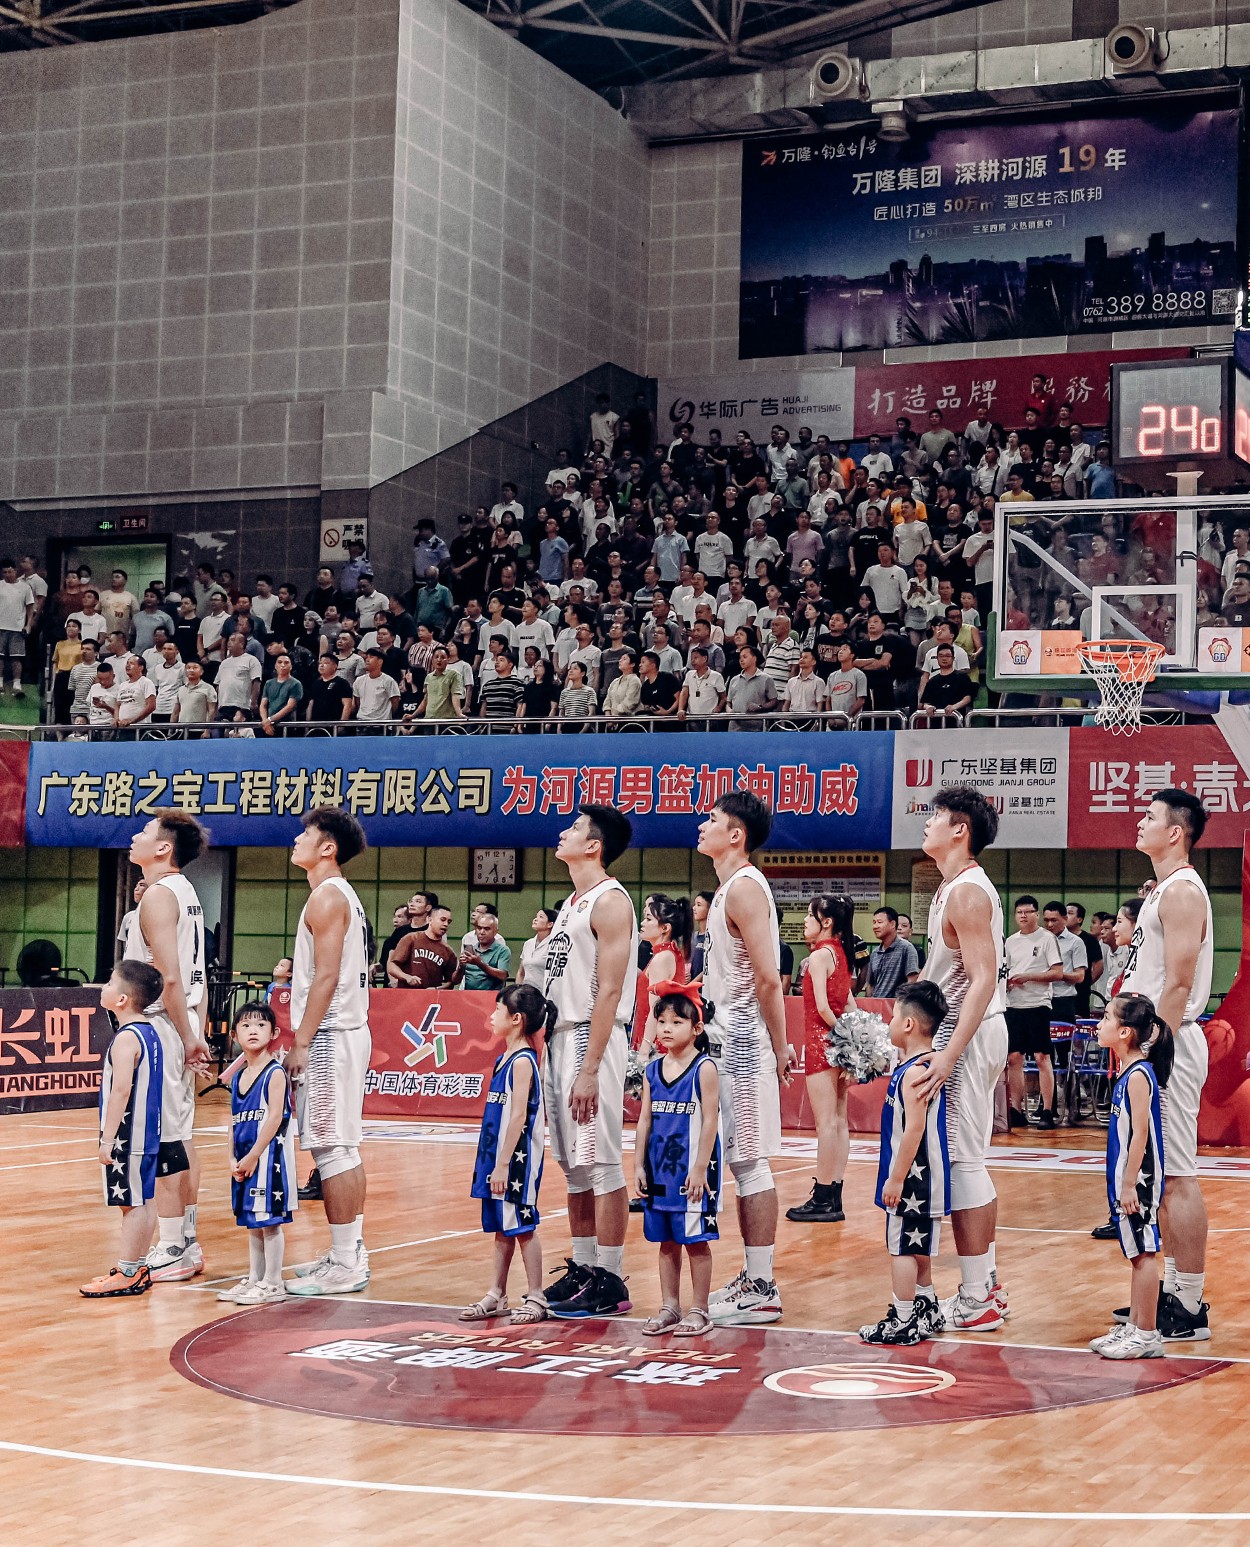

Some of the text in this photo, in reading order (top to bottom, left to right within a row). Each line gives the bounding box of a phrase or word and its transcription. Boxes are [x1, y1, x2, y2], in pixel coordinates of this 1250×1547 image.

[852, 145, 1127, 195] 万隆集团 深耕河源 19 年
[873, 187, 1103, 222] 匠心打造 湾区生态城邦
[1083, 307, 1104, 317] 0762
[1106, 295, 1146, 315] 389
[1152, 290, 1206, 312] 8888
[699, 398, 780, 420] 华际广告
[782, 403, 842, 414] ADVERTISING
[867, 391, 998, 417] 打造品牌
[940, 757, 1057, 776] 广东坚基集团
[37, 768, 493, 817] 广东路之宝工程材料有限公司
[501, 763, 860, 817] 为河源男篮加油助威
[1008, 796, 1056, 808] 坚基地产
[414, 948, 444, 966] ADIDAS
[364, 1071, 483, 1099] 中国体育彩票
[408, 1332, 738, 1362] PEARL RIVER
[286, 1339, 742, 1387] 珠江啤酒
